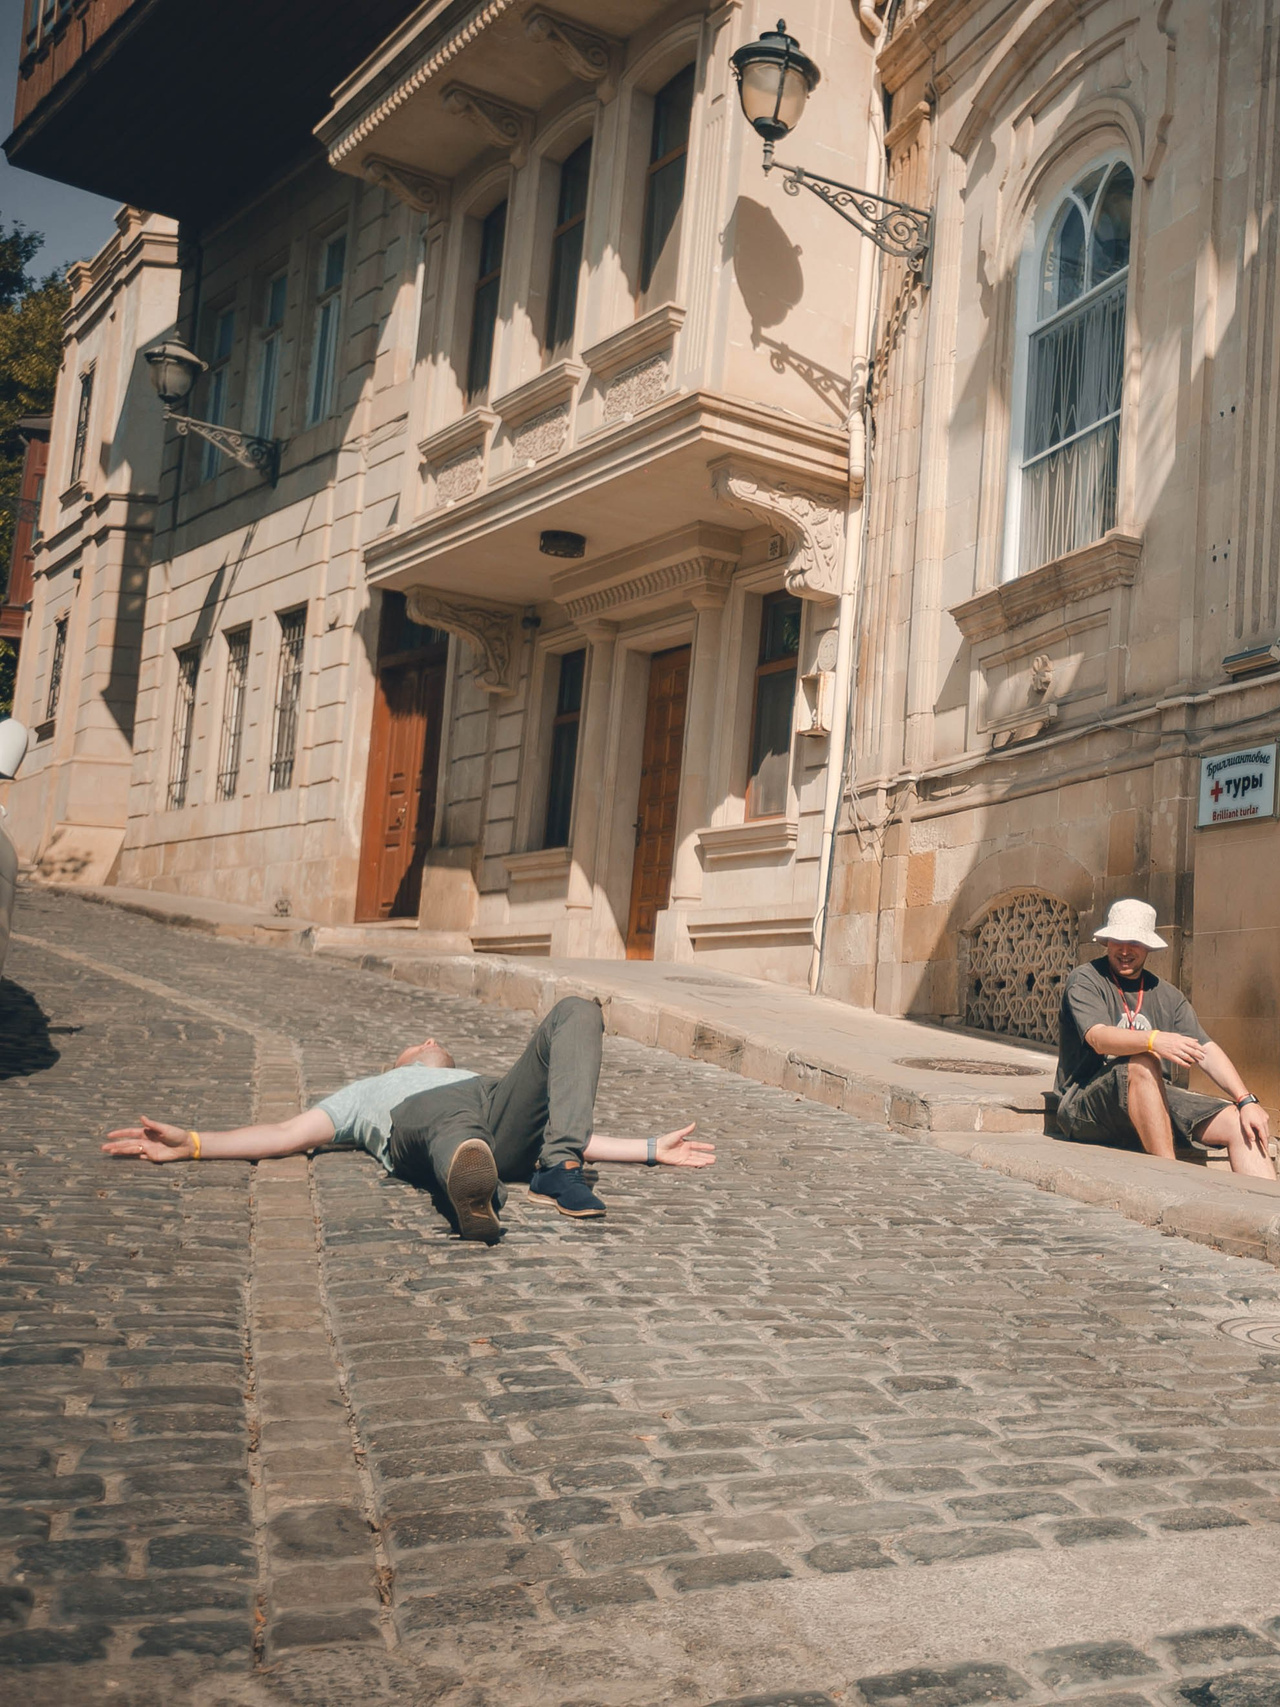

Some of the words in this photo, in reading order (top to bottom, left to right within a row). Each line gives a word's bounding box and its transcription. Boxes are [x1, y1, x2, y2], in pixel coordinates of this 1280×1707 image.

[1206, 751, 1271, 779] Бриллиантовые
[1225, 773, 1263, 798] туры
[1212, 808, 1239, 821] Brilliant
[1239, 804, 1259, 817] turlar
